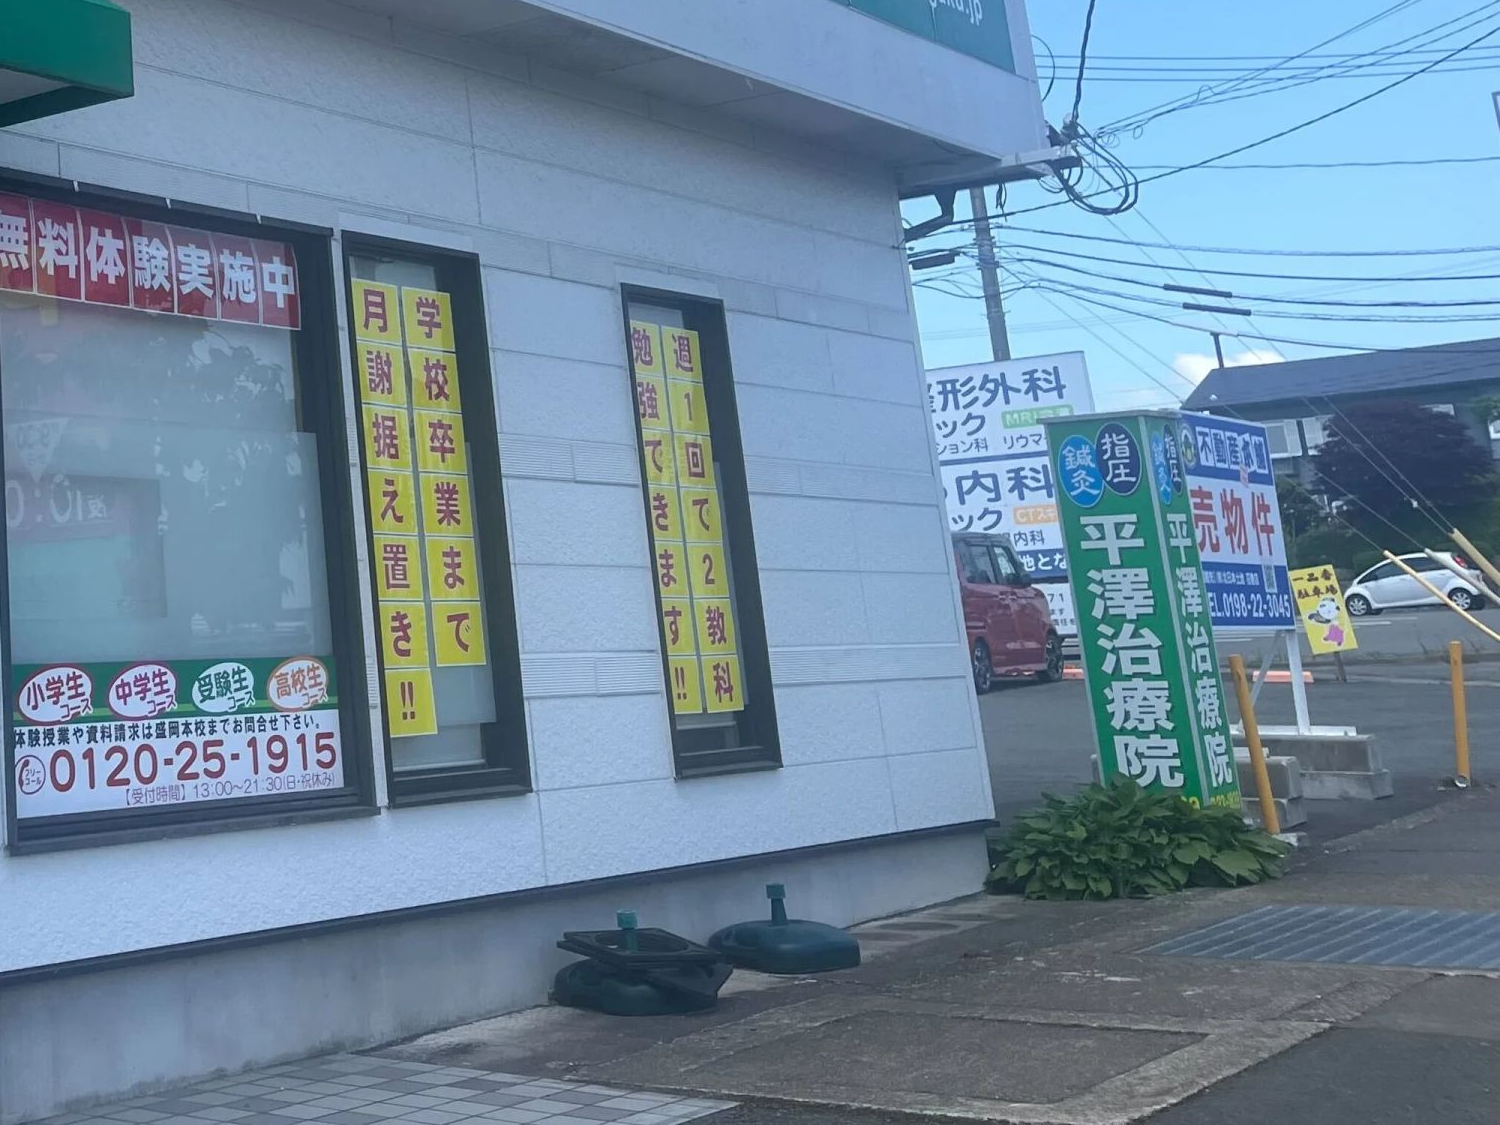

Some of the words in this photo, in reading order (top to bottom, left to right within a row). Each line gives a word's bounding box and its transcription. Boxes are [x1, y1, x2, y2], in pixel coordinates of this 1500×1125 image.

[936, 412, 986, 438] ック
[1003, 433, 1046, 450] リウマ
[415, 295, 471, 655] 学校卒業まで
[1061, 445, 1100, 496] 鍼灸
[1101, 432, 1137, 483] 指圧
[943, 463, 1054, 505] 内科
[670, 332, 735, 705] 週1回で2教科
[951, 507, 1003, 532] ック
[1190, 485, 1275, 557] 売物件
[1079, 513, 1185, 788] 平澤治療院
[1166, 513, 1233, 788] 平澤治療院
[26, 671, 86, 711] 小学生
[115, 669, 171, 706] 中学生
[198, 665, 250, 699] 受験生
[275, 662, 323, 698] 高校生
[301, 686, 328, 707] コース
[59, 698, 92, 720] コース
[146, 694, 177, 716] コース
[227, 691, 255, 711] コース
[14, 713, 320, 749] 体験授業や資料請求は盛岡本校までお問合せ下さい。
[49, 731, 337, 793] 0120-25-1915
